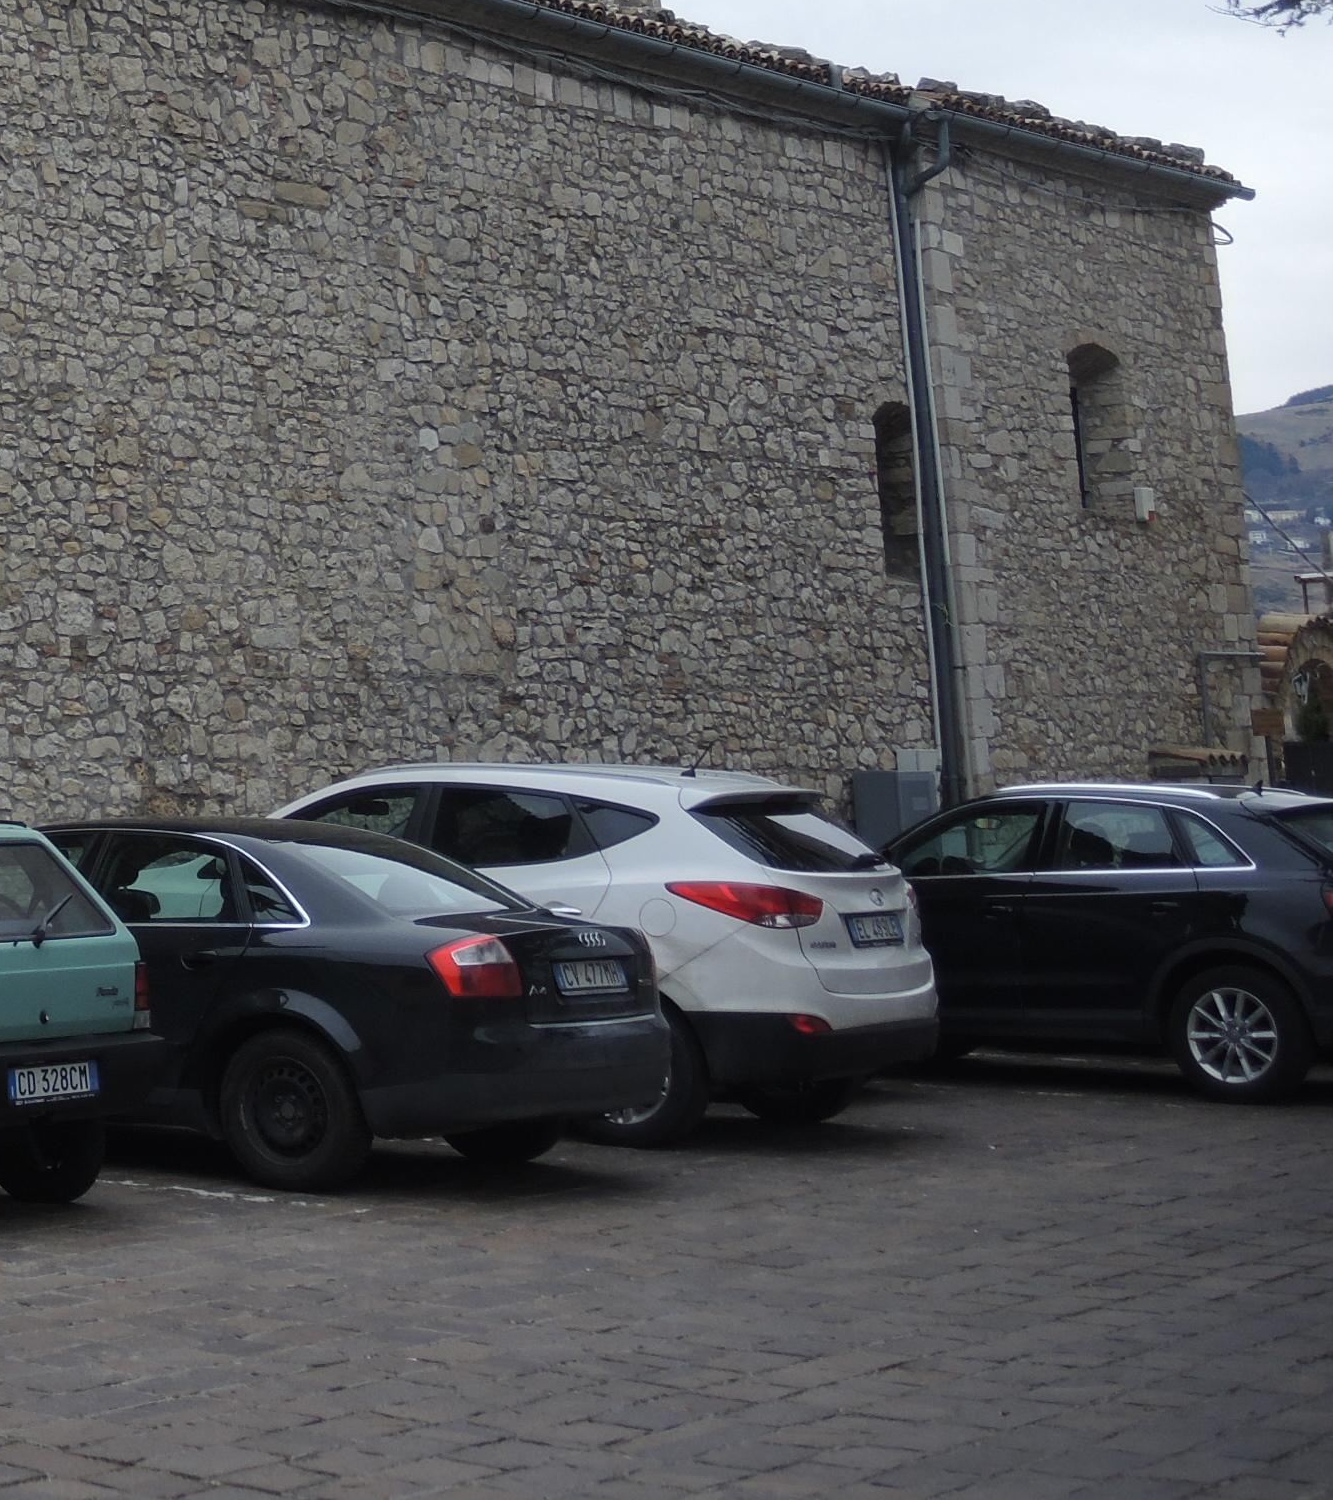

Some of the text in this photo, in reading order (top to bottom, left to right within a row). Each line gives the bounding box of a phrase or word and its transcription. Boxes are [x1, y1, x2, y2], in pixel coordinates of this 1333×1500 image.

[563, 963, 580, 987] CV
[18, 1064, 89, 1096] CD 328CM
